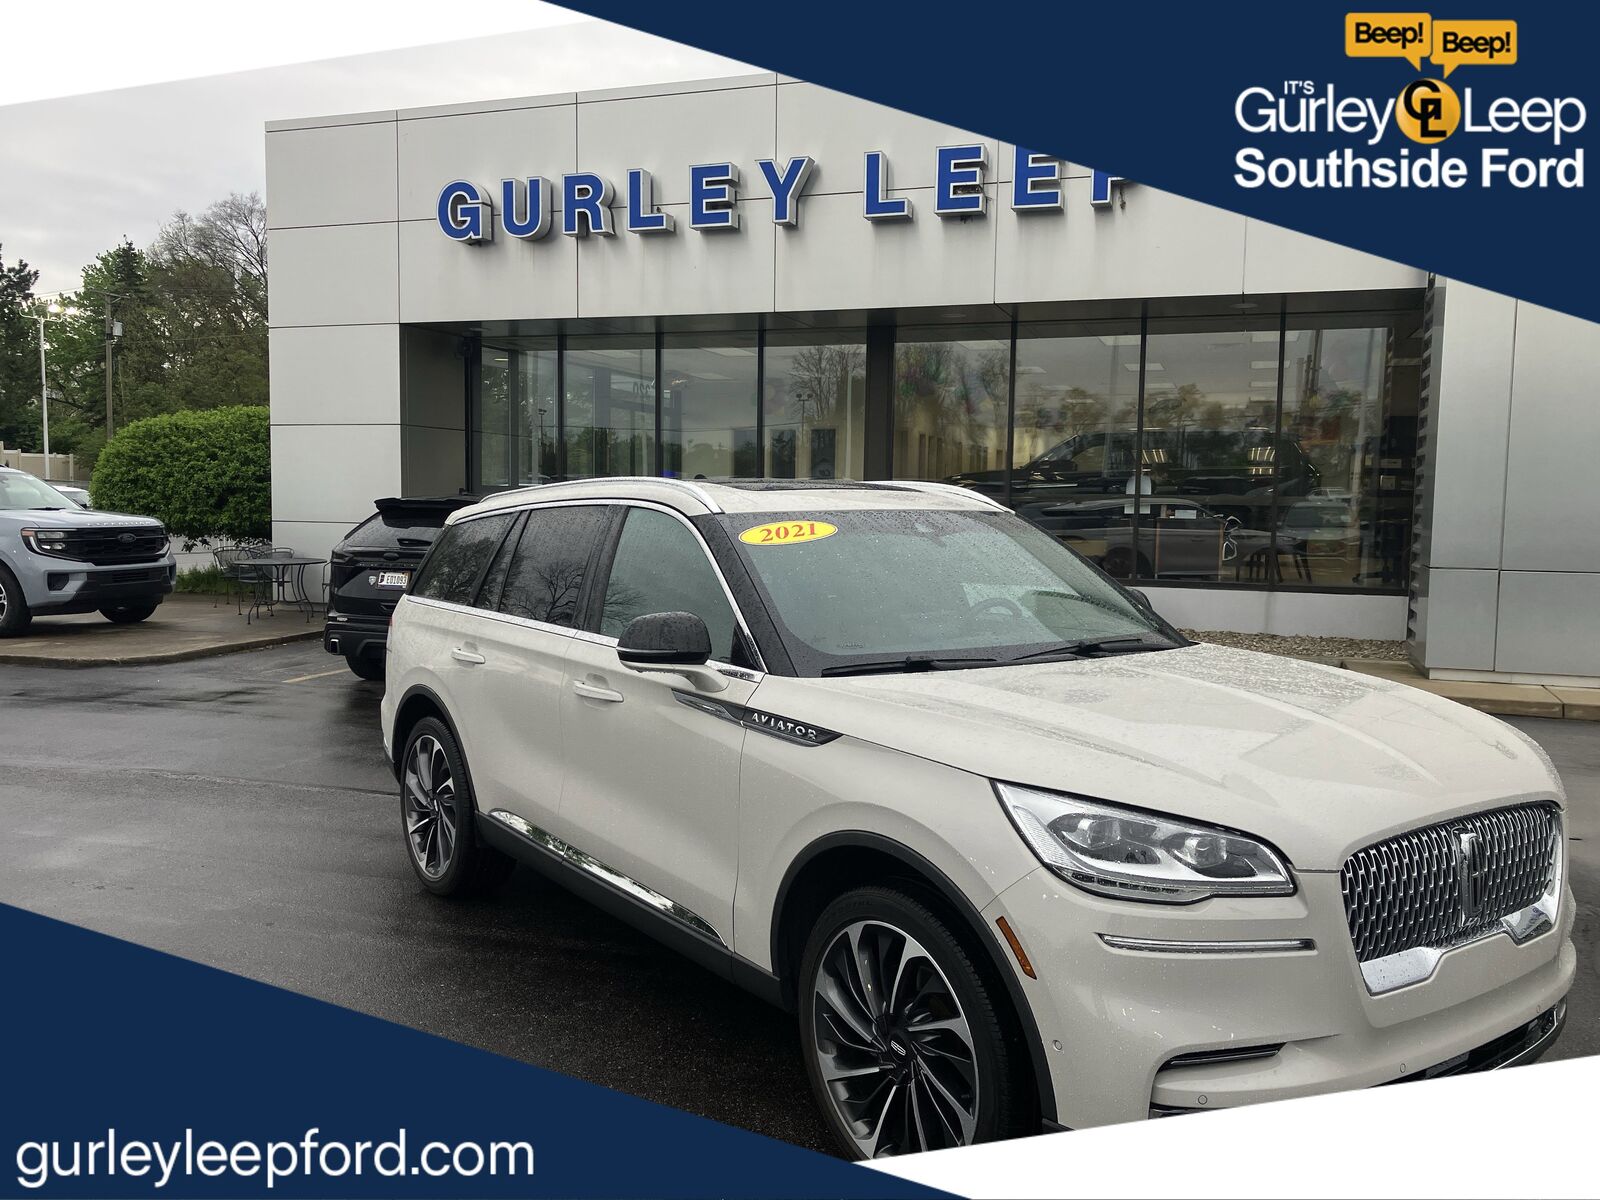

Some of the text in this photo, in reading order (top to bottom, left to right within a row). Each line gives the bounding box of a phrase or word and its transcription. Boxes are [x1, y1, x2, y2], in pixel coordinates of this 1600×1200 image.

[436, 156, 815, 245] GURLEY
[760, 523, 817, 542] 2021
[751, 712, 817, 740] AVIATOR
